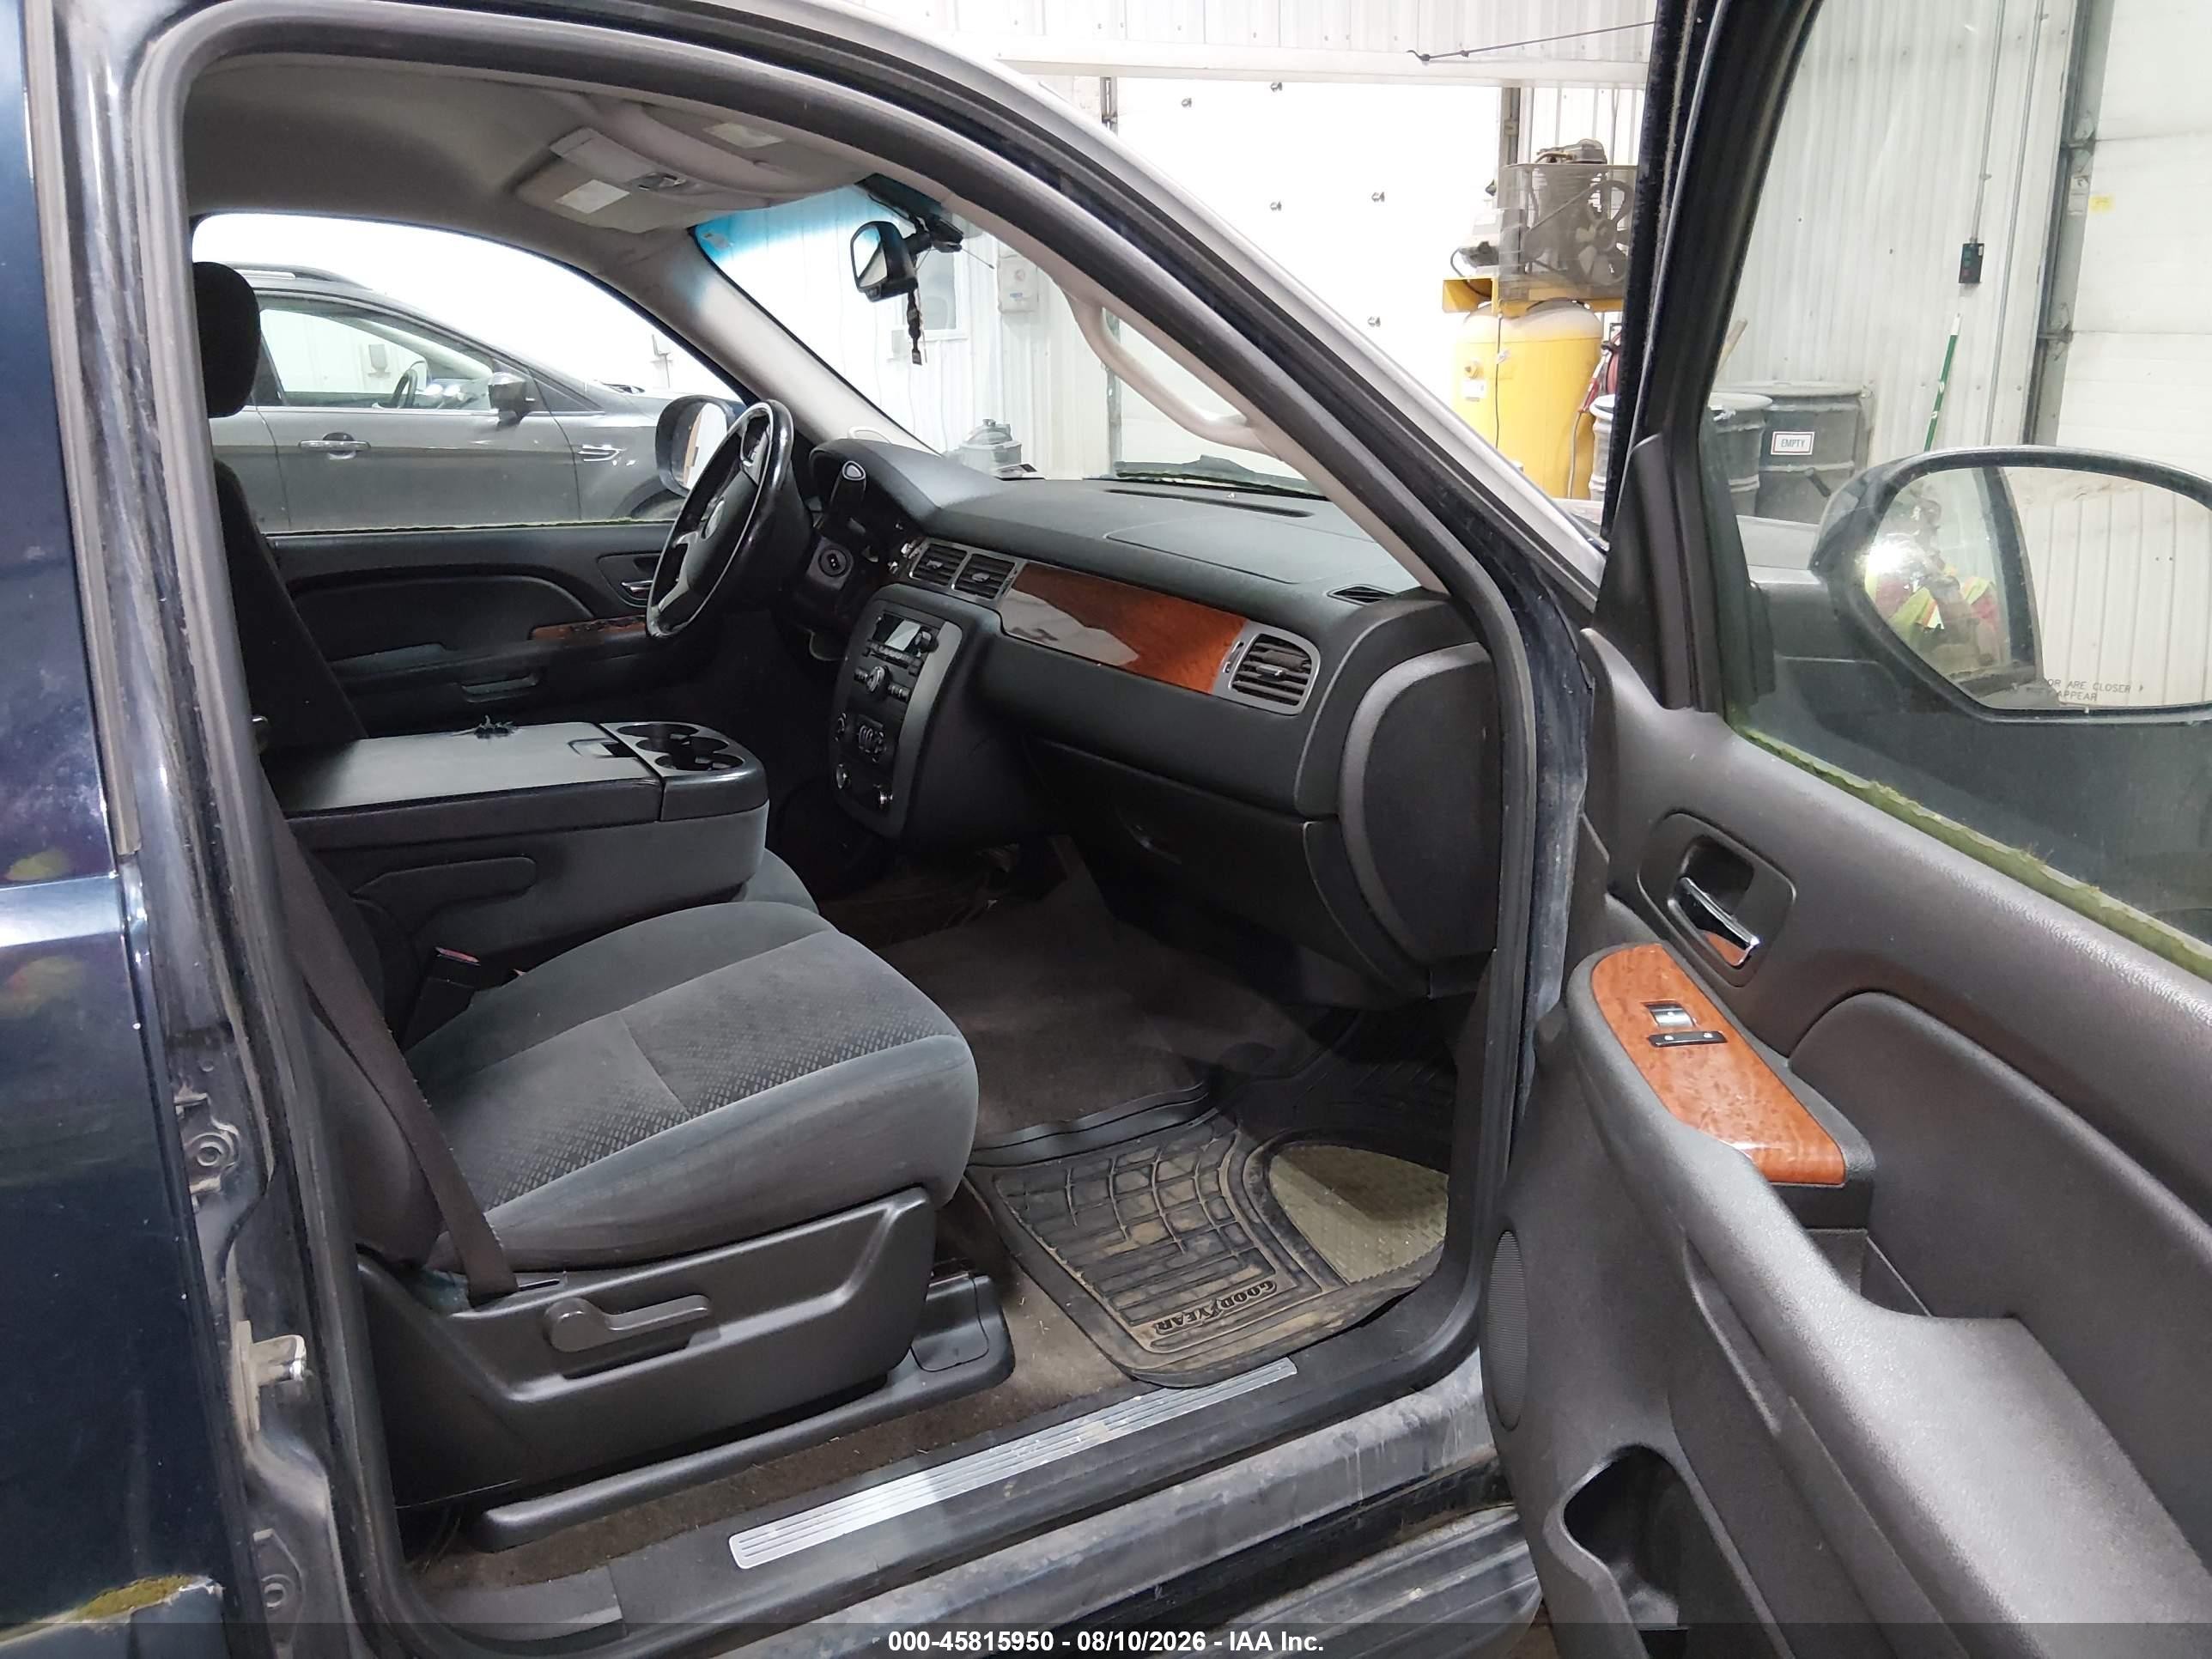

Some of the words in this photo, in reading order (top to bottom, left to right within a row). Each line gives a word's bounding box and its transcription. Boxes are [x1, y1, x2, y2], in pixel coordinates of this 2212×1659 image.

[1781, 439, 1806, 448] EMPTY
[2067, 680, 2087, 690] ARE
[2093, 682, 2131, 694] CLOSER
[2057, 690, 2098, 702] APPEAR
[1155, 1279, 1277, 1331] GOODYEAR
